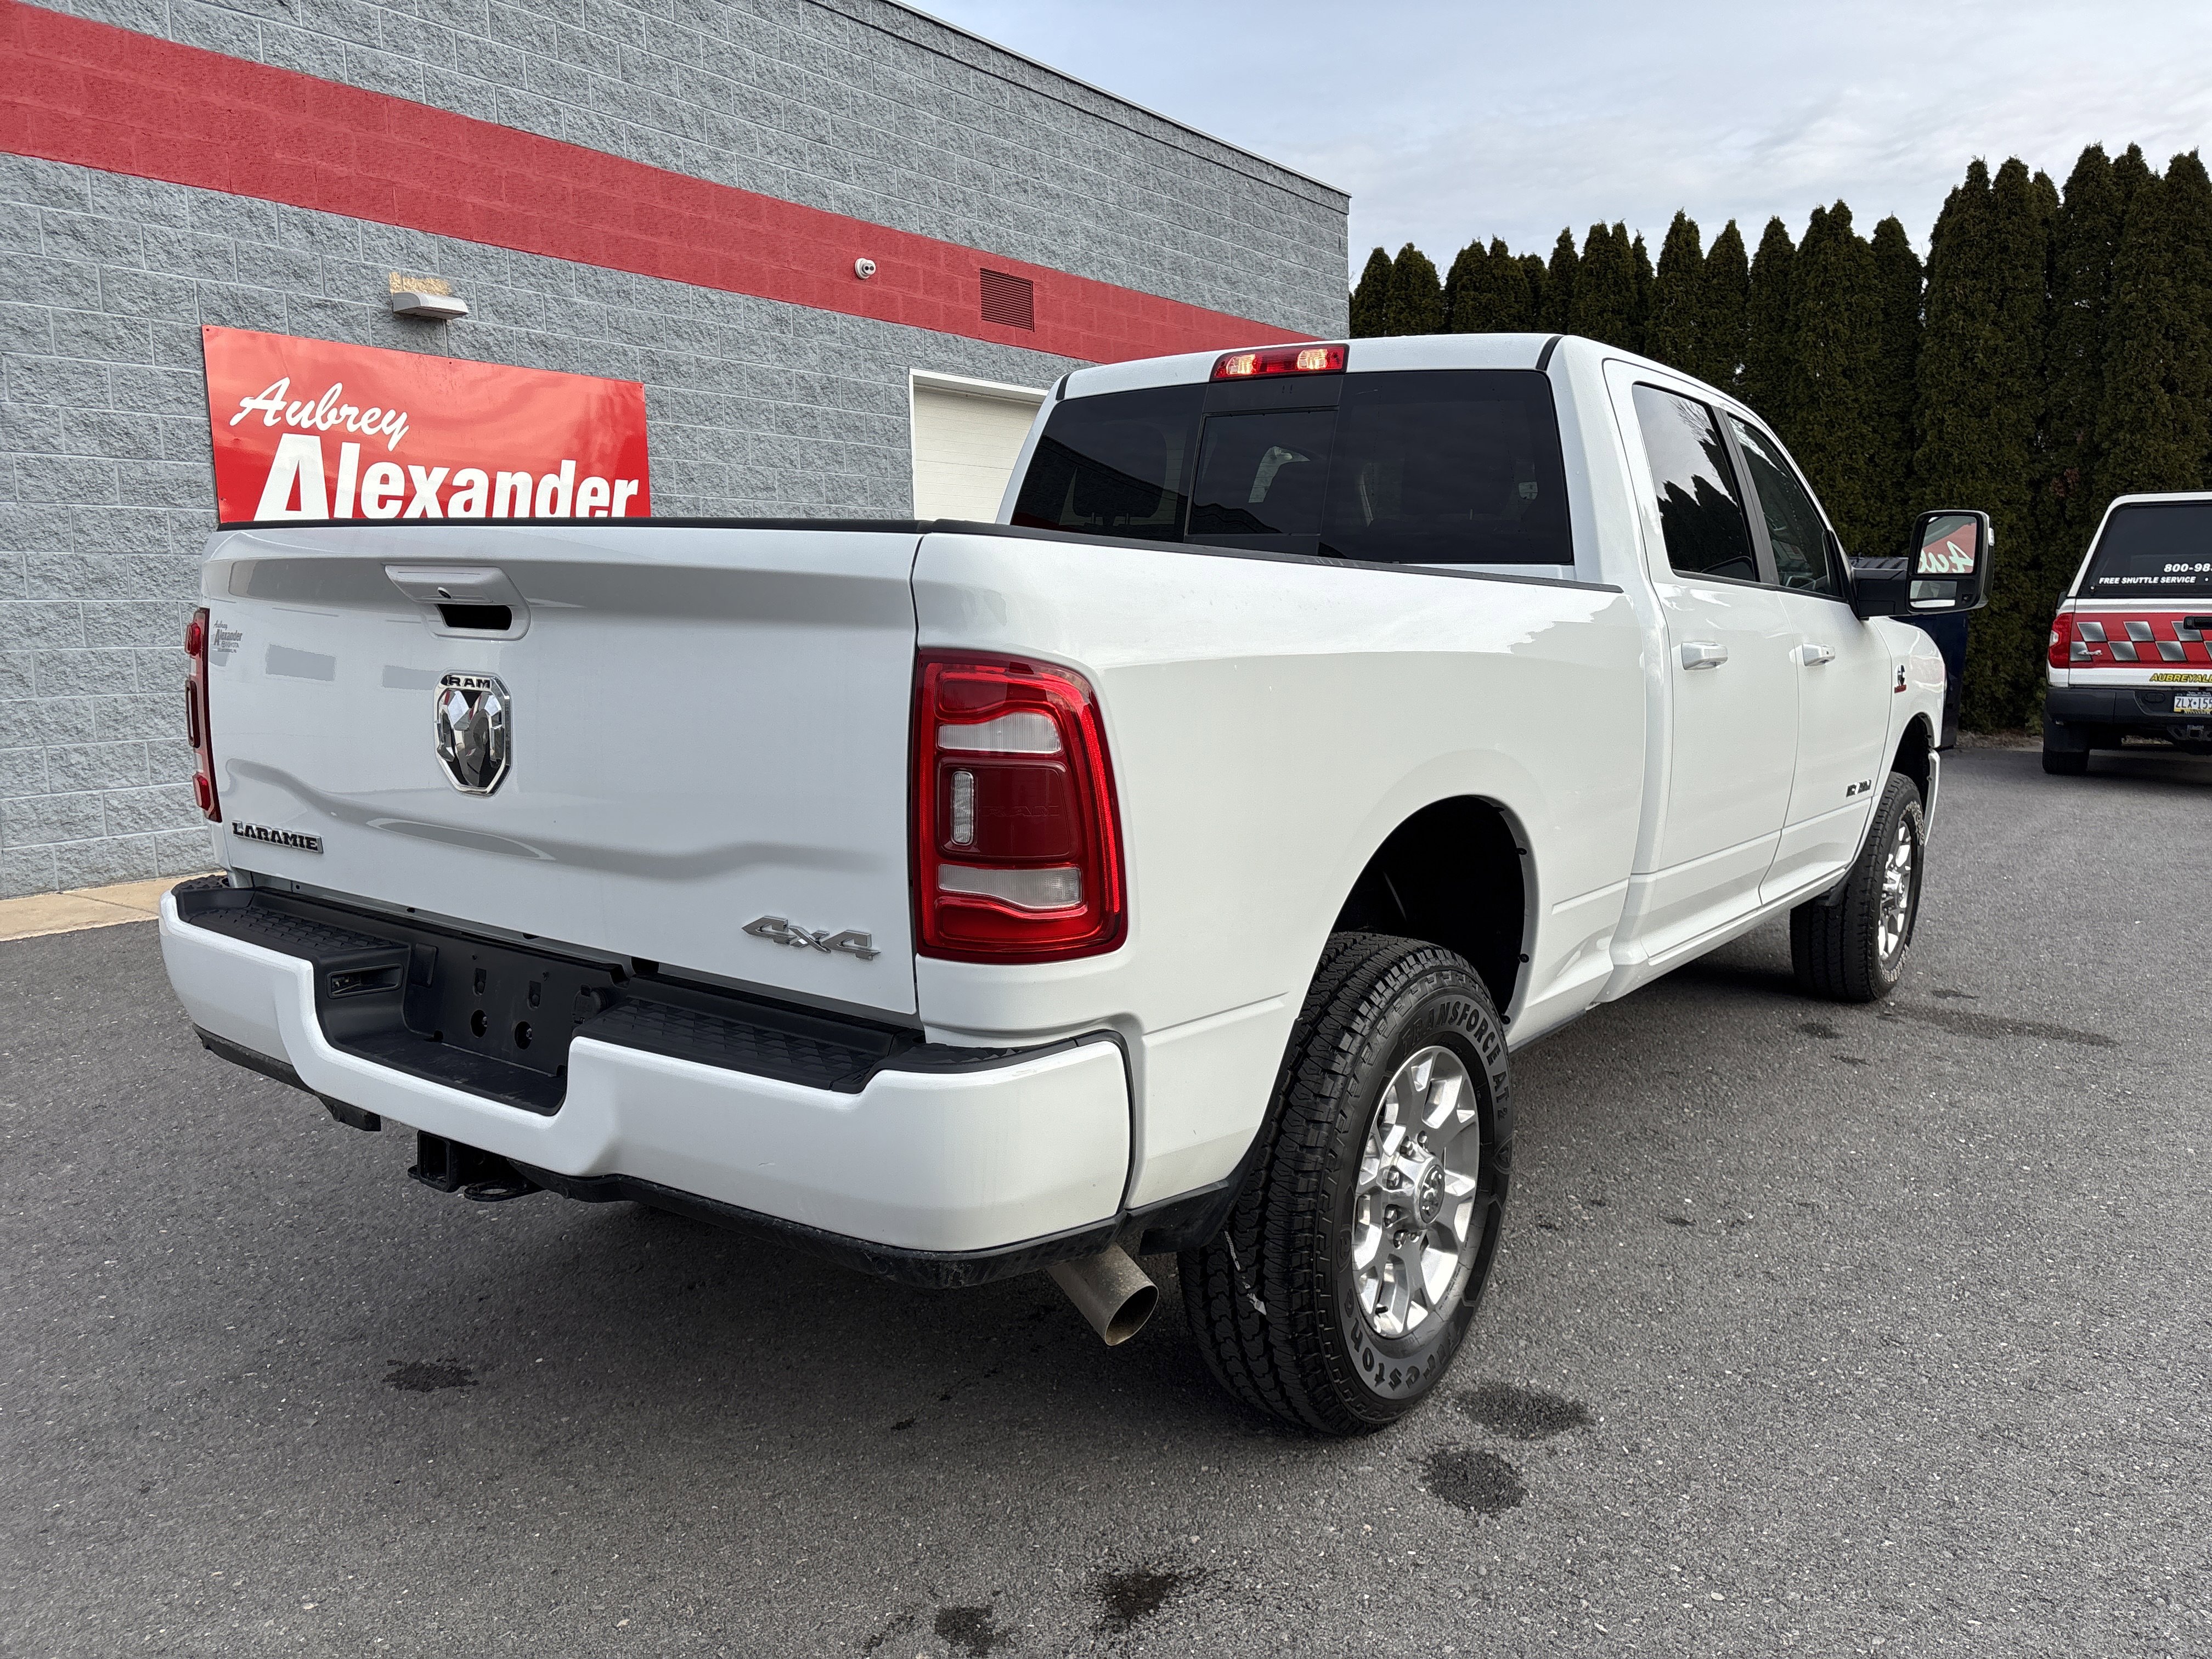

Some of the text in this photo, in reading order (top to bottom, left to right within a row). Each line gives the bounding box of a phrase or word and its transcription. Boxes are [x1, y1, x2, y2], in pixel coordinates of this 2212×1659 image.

[230, 377, 410, 452] Aubrey
[253, 433, 639, 521] Alexander
[2164, 563, 2212, 572] 800-98
[213, 629, 242, 646] Alexander
[447, 676, 491, 689] RAM
[981, 805, 1059, 817] RAM
[232, 821, 322, 854] LARAMIE
[1402, 1001, 1501, 1066] TRANSFORCE
